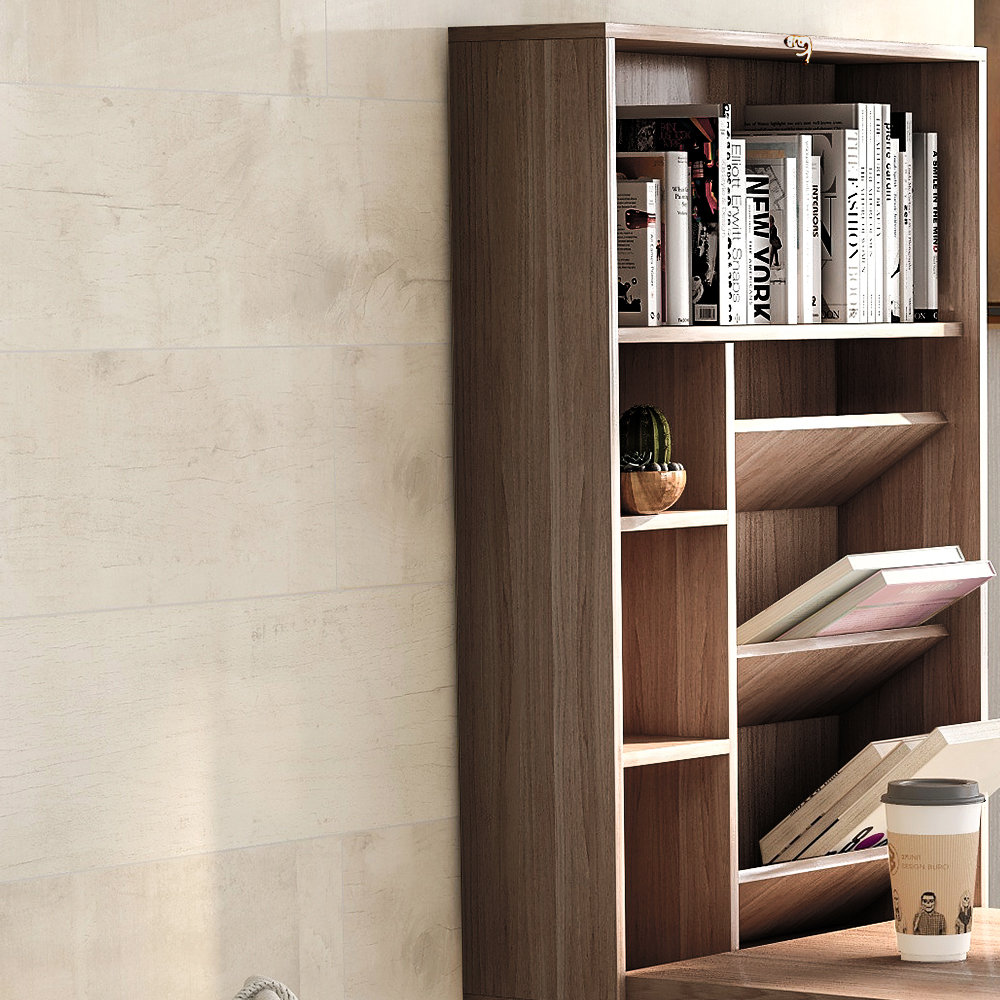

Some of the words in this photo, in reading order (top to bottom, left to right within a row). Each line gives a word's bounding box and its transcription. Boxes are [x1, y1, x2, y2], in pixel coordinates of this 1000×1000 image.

[731, 144, 742, 188] Elliott
[932, 150, 938, 158] A
[731, 195, 742, 240] Erwitt
[746, 177, 769, 239] NEW
[847, 178, 858, 259] FASHION
[932, 192, 938, 205] IN
[754, 246, 770, 322] YORK
